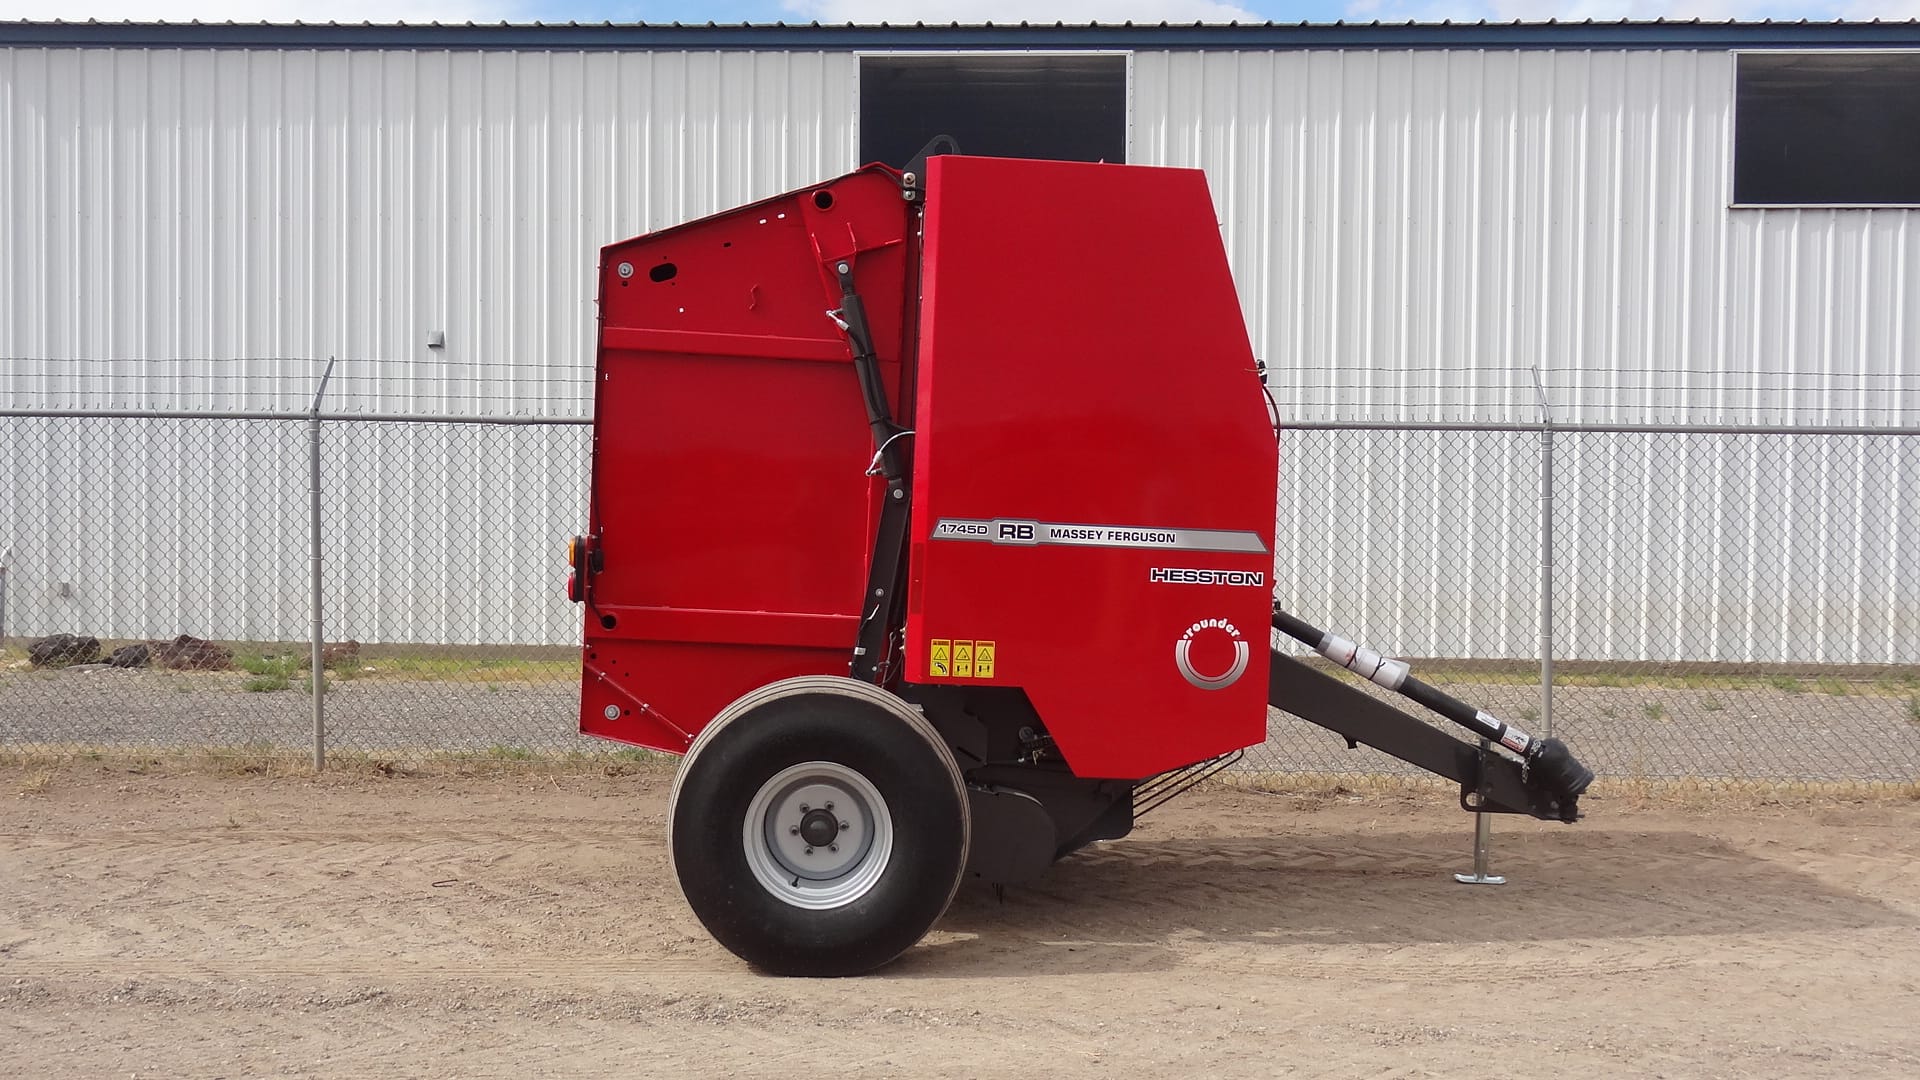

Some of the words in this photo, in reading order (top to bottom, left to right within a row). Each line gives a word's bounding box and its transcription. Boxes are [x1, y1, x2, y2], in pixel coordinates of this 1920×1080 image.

[939, 523, 988, 535] 1745D
[999, 523, 1035, 540] RB
[1050, 528, 1103, 541] MASSEY
[1107, 530, 1176, 543] FERGUSON
[1151, 568, 1263, 586] HESSTON
